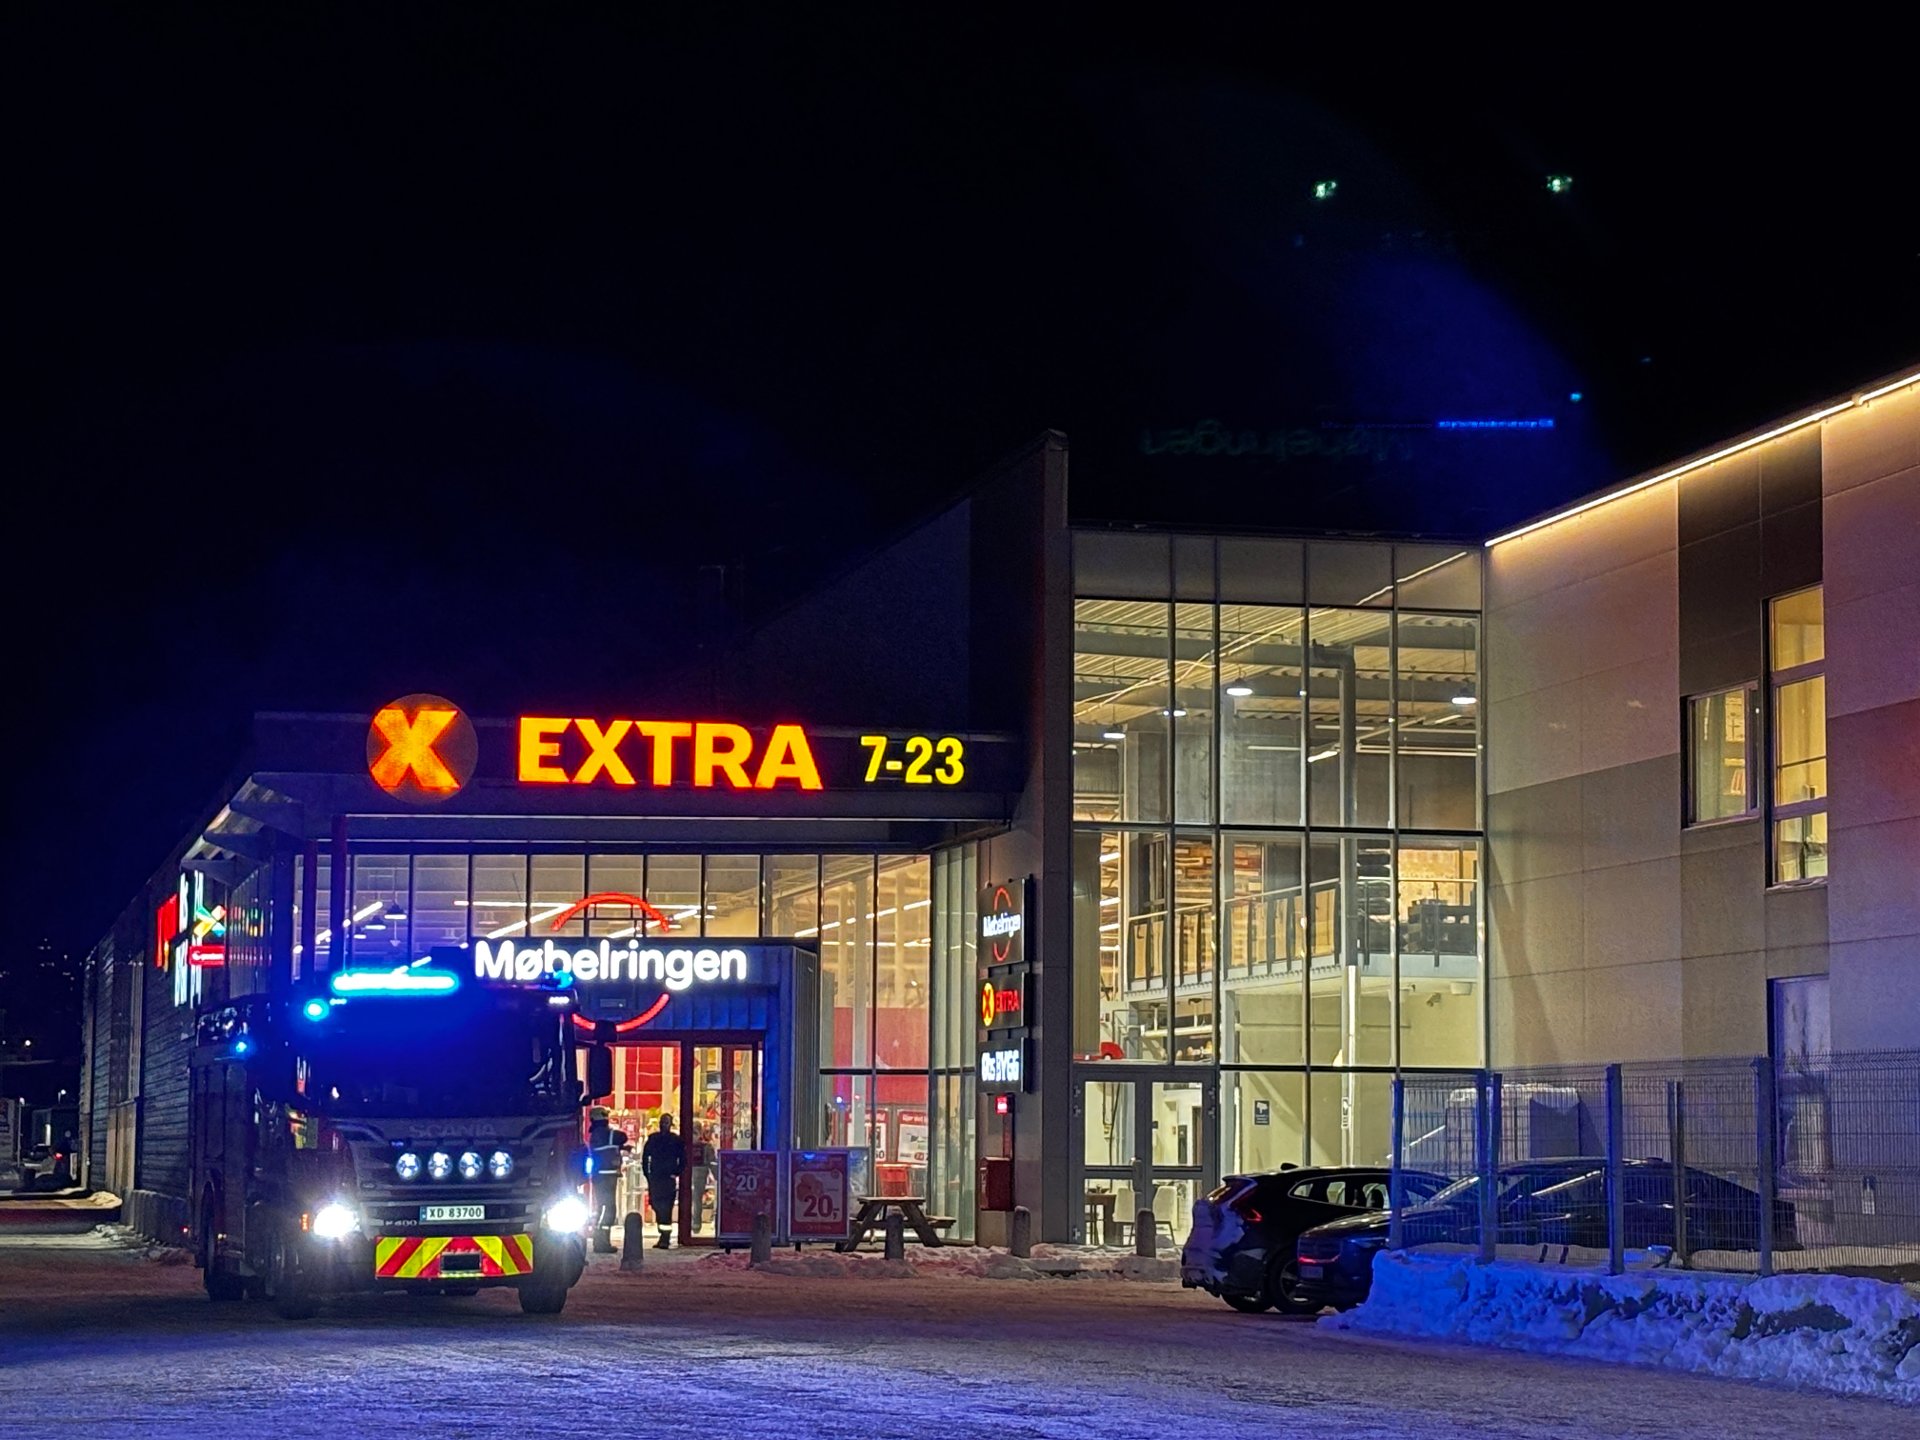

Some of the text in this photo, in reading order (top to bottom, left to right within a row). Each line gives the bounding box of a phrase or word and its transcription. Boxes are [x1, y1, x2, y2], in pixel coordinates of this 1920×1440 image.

[518, 716, 824, 791] EXTRA
[859, 735, 966, 785] 7-23
[475, 939, 748, 991] Møbelringen
[996, 990, 1020, 1013] EXTRA
[995, 1050, 1020, 1082] BYGG
[409, 1124, 497, 1138] SCANIA
[736, 1174, 758, 1191] 20
[430, 1207, 482, 1218] XD 83700
